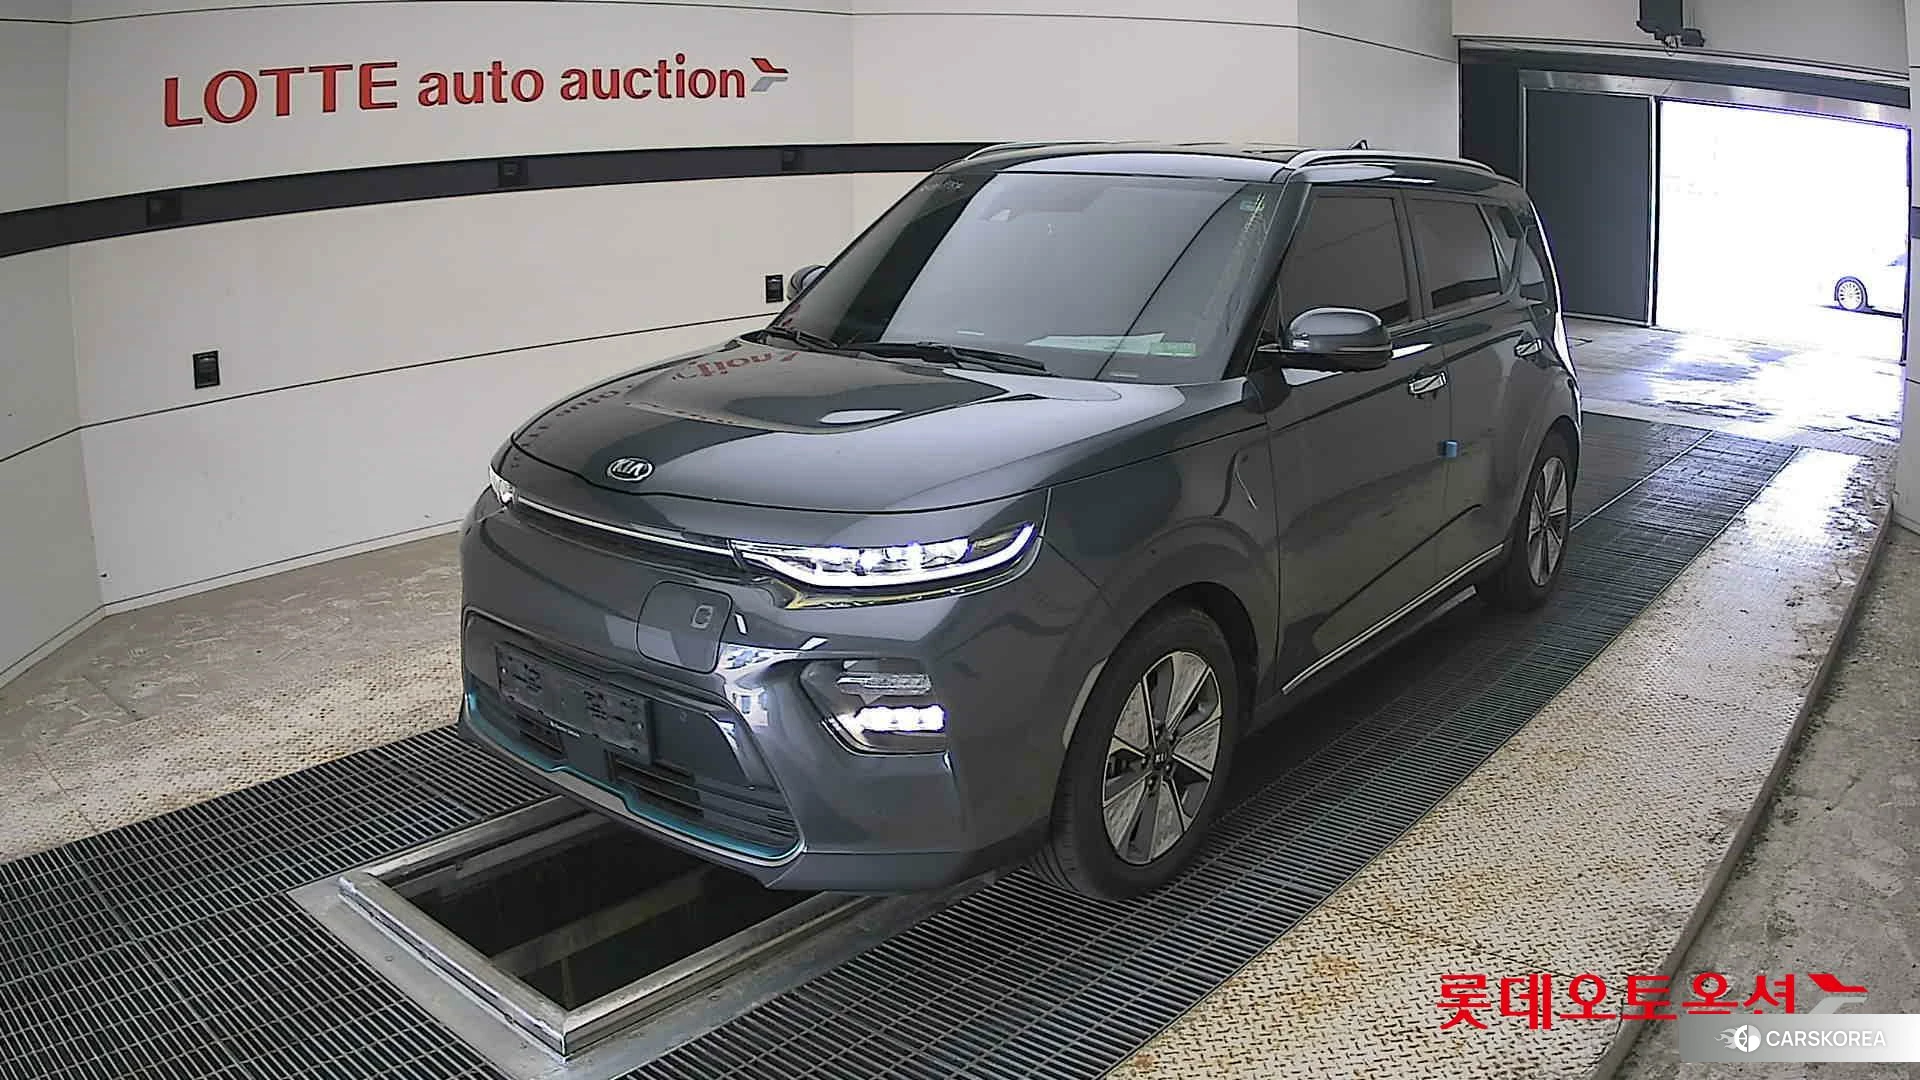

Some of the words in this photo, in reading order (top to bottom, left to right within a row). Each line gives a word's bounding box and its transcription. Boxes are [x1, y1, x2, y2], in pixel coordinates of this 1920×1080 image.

[163, 62, 399, 128] LOTTE
[417, 62, 546, 107] auto
[560, 53, 748, 102] auction
[611, 460, 648, 476] KIA
